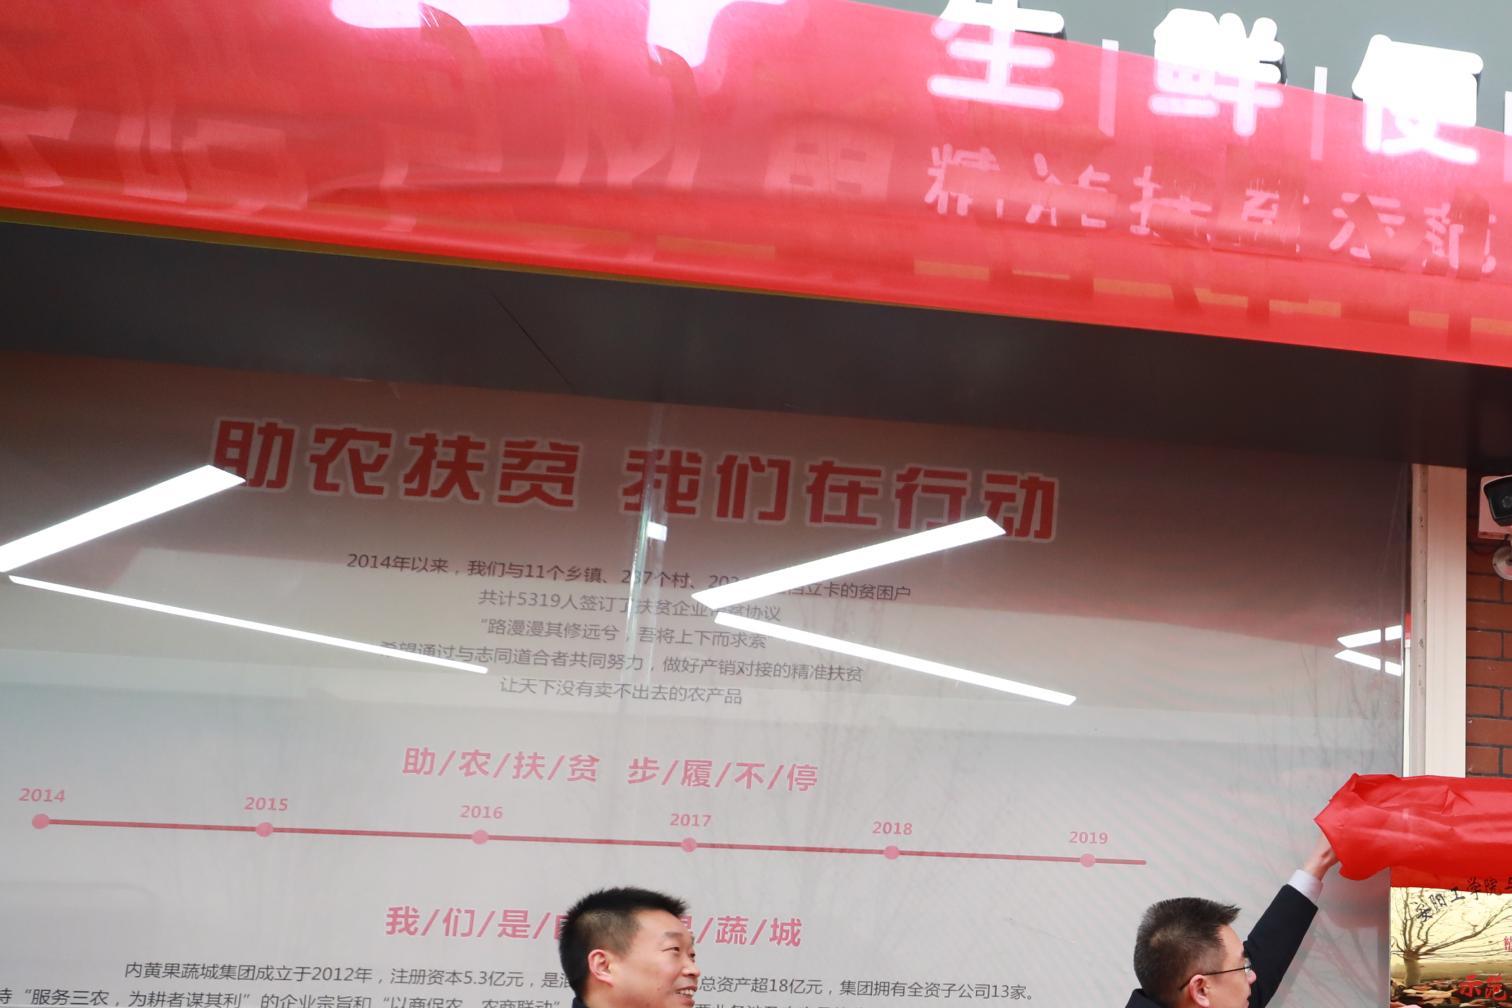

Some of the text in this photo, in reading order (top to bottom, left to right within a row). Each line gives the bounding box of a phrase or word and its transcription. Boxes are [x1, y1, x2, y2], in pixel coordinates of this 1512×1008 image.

[210, 418, 1058, 540] 助农扶贫 我们在行动
[500, 676, 742, 705] 让天下没有卖不出去的农产品
[19, 787, 1109, 845] 2014 2015 2016 2017 2018 2019
